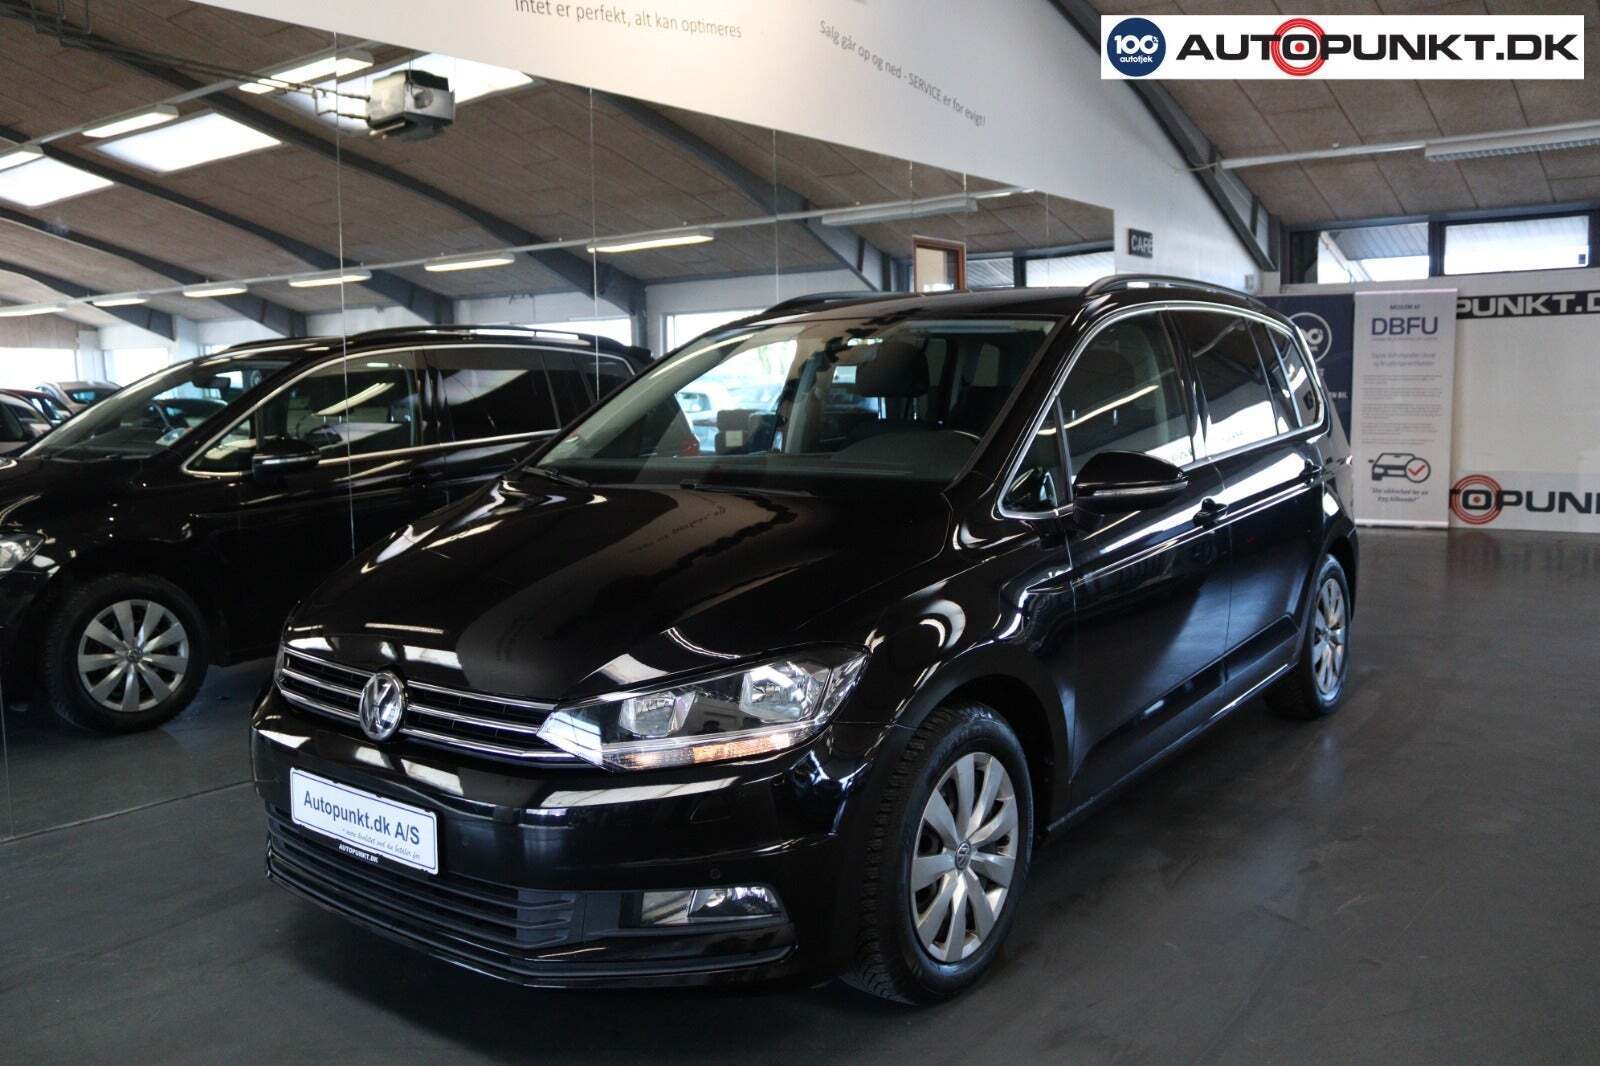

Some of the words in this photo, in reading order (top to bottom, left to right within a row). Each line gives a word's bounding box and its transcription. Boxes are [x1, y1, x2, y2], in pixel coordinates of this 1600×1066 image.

[556, 3, 570, 17] er
[576, 4, 631, 27] perfekt,
[635, 8, 652, 27] alt
[655, 11, 678, 30] kan
[681, 17, 742, 38] optimeres
[819, 19, 840, 46] Salg
[857, 46, 870, 63] op
[872, 54, 883, 72] og
[885, 62, 902, 79] ned
[908, 72, 941, 102] SERVICE
[953, 97, 964, 113] for
[1371, 316, 1438, 335] DBFU
[1449, 489, 1600, 514] OPUN
[303, 790, 391, 837] Autopunkt.dk
[394, 821, 421, 846] A/S
